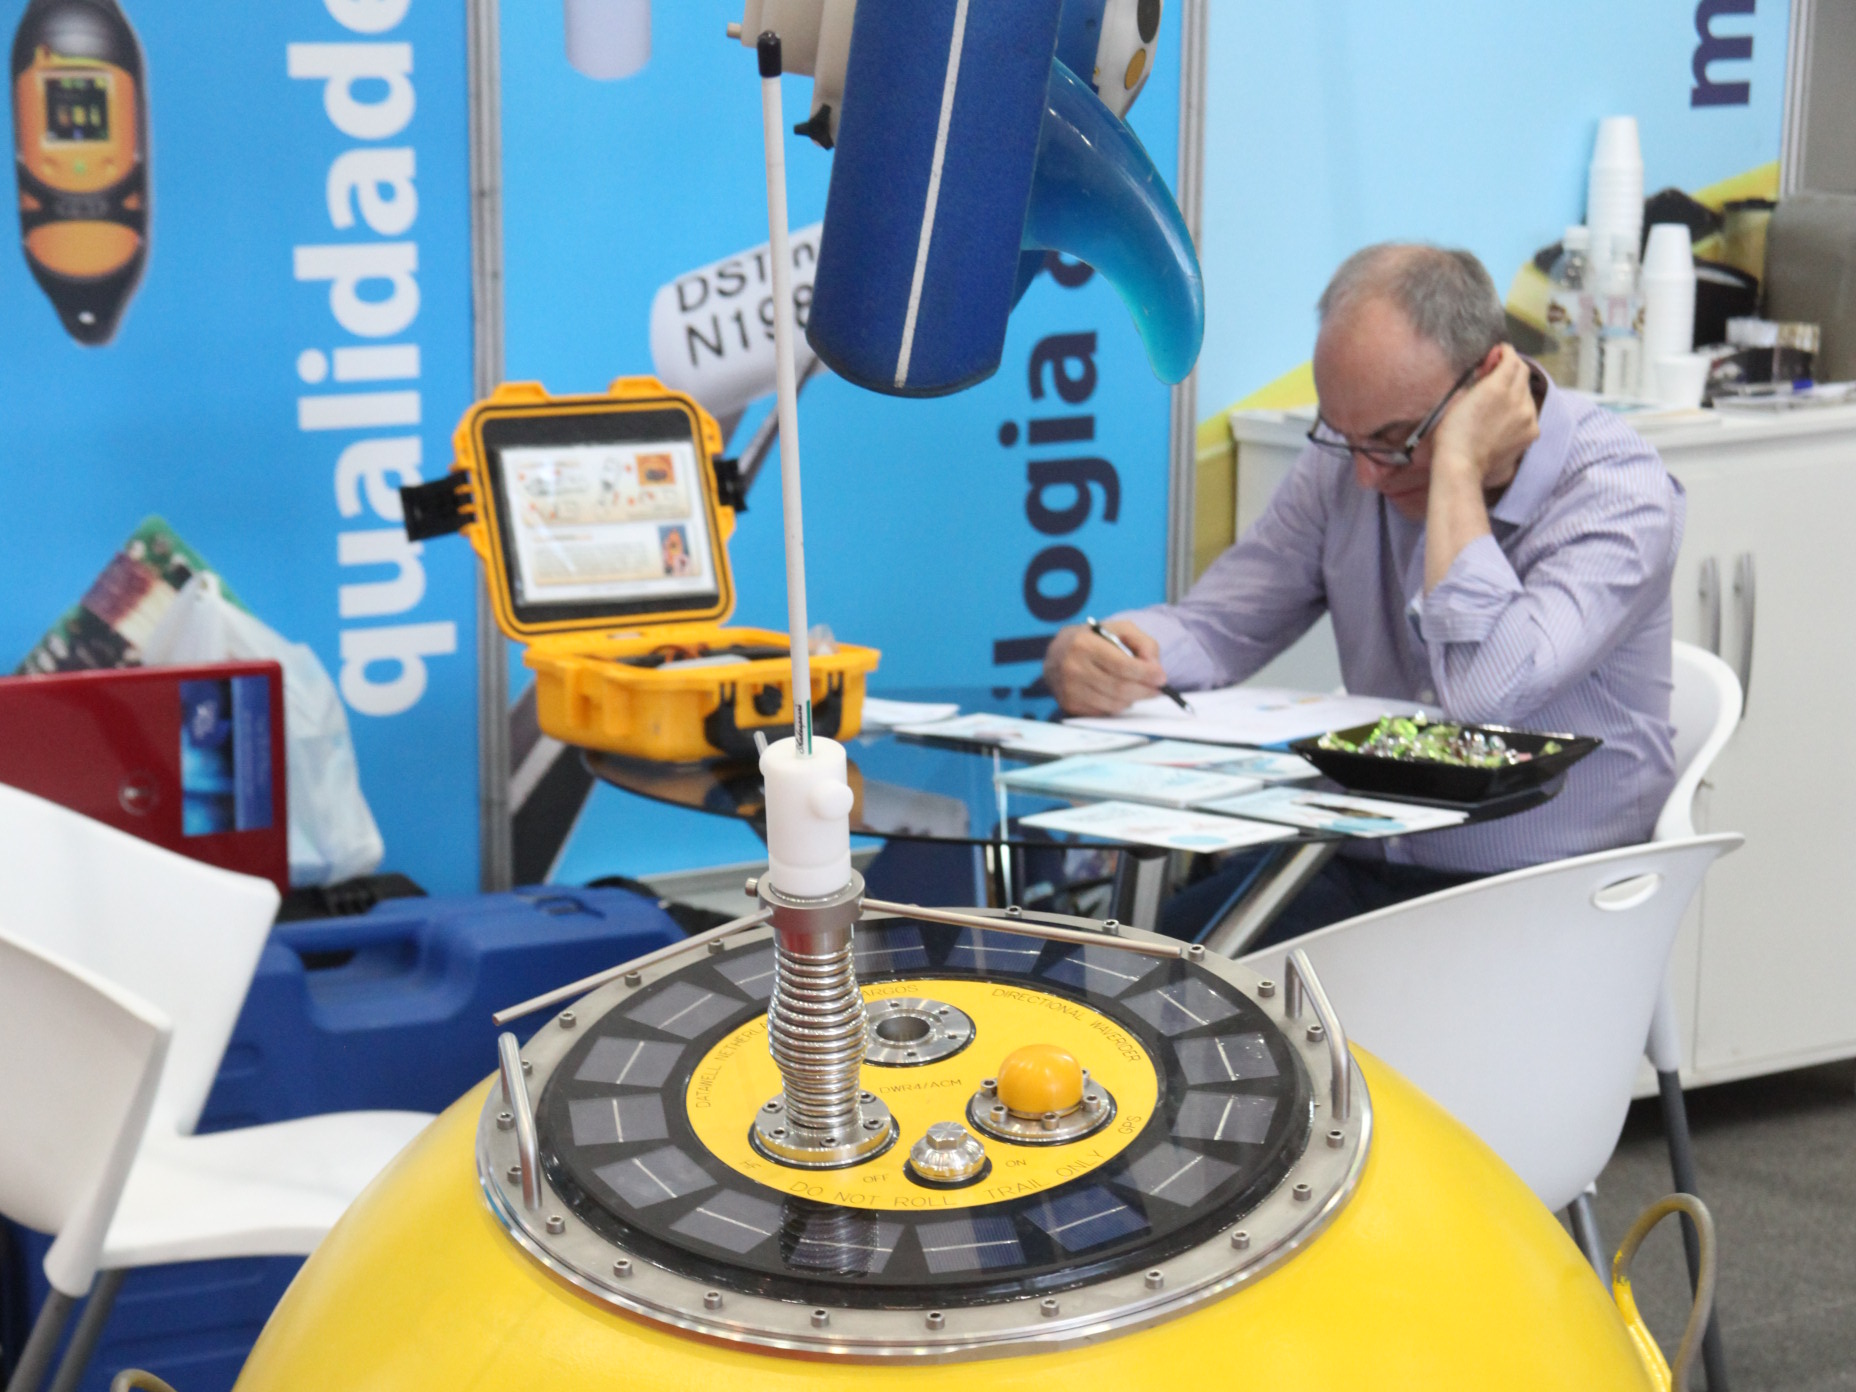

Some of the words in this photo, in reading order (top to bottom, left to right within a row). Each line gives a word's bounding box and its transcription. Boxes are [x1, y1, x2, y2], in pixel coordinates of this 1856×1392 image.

[992, 330, 1122, 690] logia
[861, 984, 919, 997] ARGOS
[992, 988, 1083, 1021] DIRECTIONAL
[1089, 1019, 1142, 1062] WAVERIDER
[696, 1064, 722, 1108] DATAWELL
[715, 1021, 768, 1063] NETHERLA
[879, 1079, 962, 1094] DWR4/ACM
[1118, 1115, 1142, 1135] GPS
[1006, 1158, 1027, 1169] ON
[790, 1181, 824, 1197] DO
[833, 1191, 880, 1206] NOT
[894, 1195, 957, 1208] ROLL
[984, 1179, 1051, 1200] TRAIL
[1055, 1150, 1106, 1180] ONLY
[863, 1173, 890, 1184] OFF
